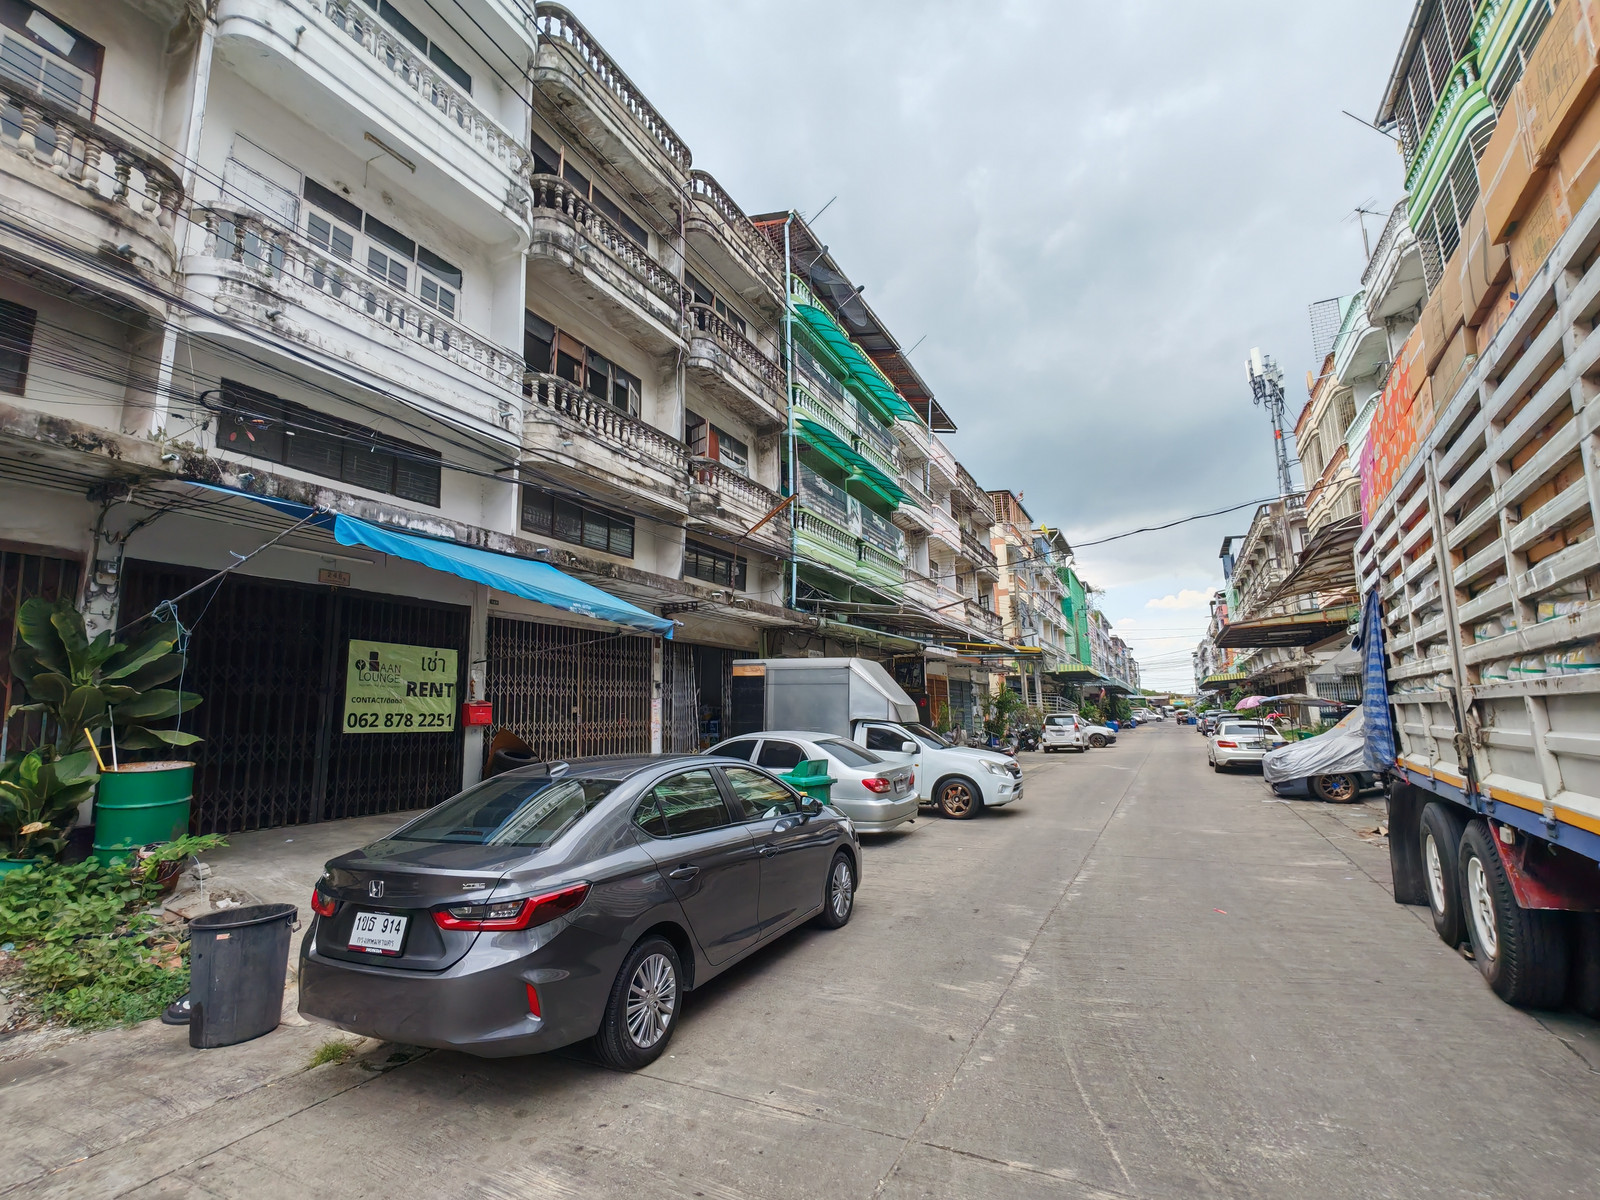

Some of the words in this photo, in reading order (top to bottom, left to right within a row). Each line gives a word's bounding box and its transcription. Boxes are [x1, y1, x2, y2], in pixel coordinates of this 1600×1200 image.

[421, 651, 446, 673] เช่า
[358, 671, 401, 684] LOUNGE
[406, 681, 454, 698] RENT
[347, 713, 379, 728] 062
[384, 713, 413, 728] 878
[418, 713, 452, 727] 2251
[381, 918, 402, 935] 914
